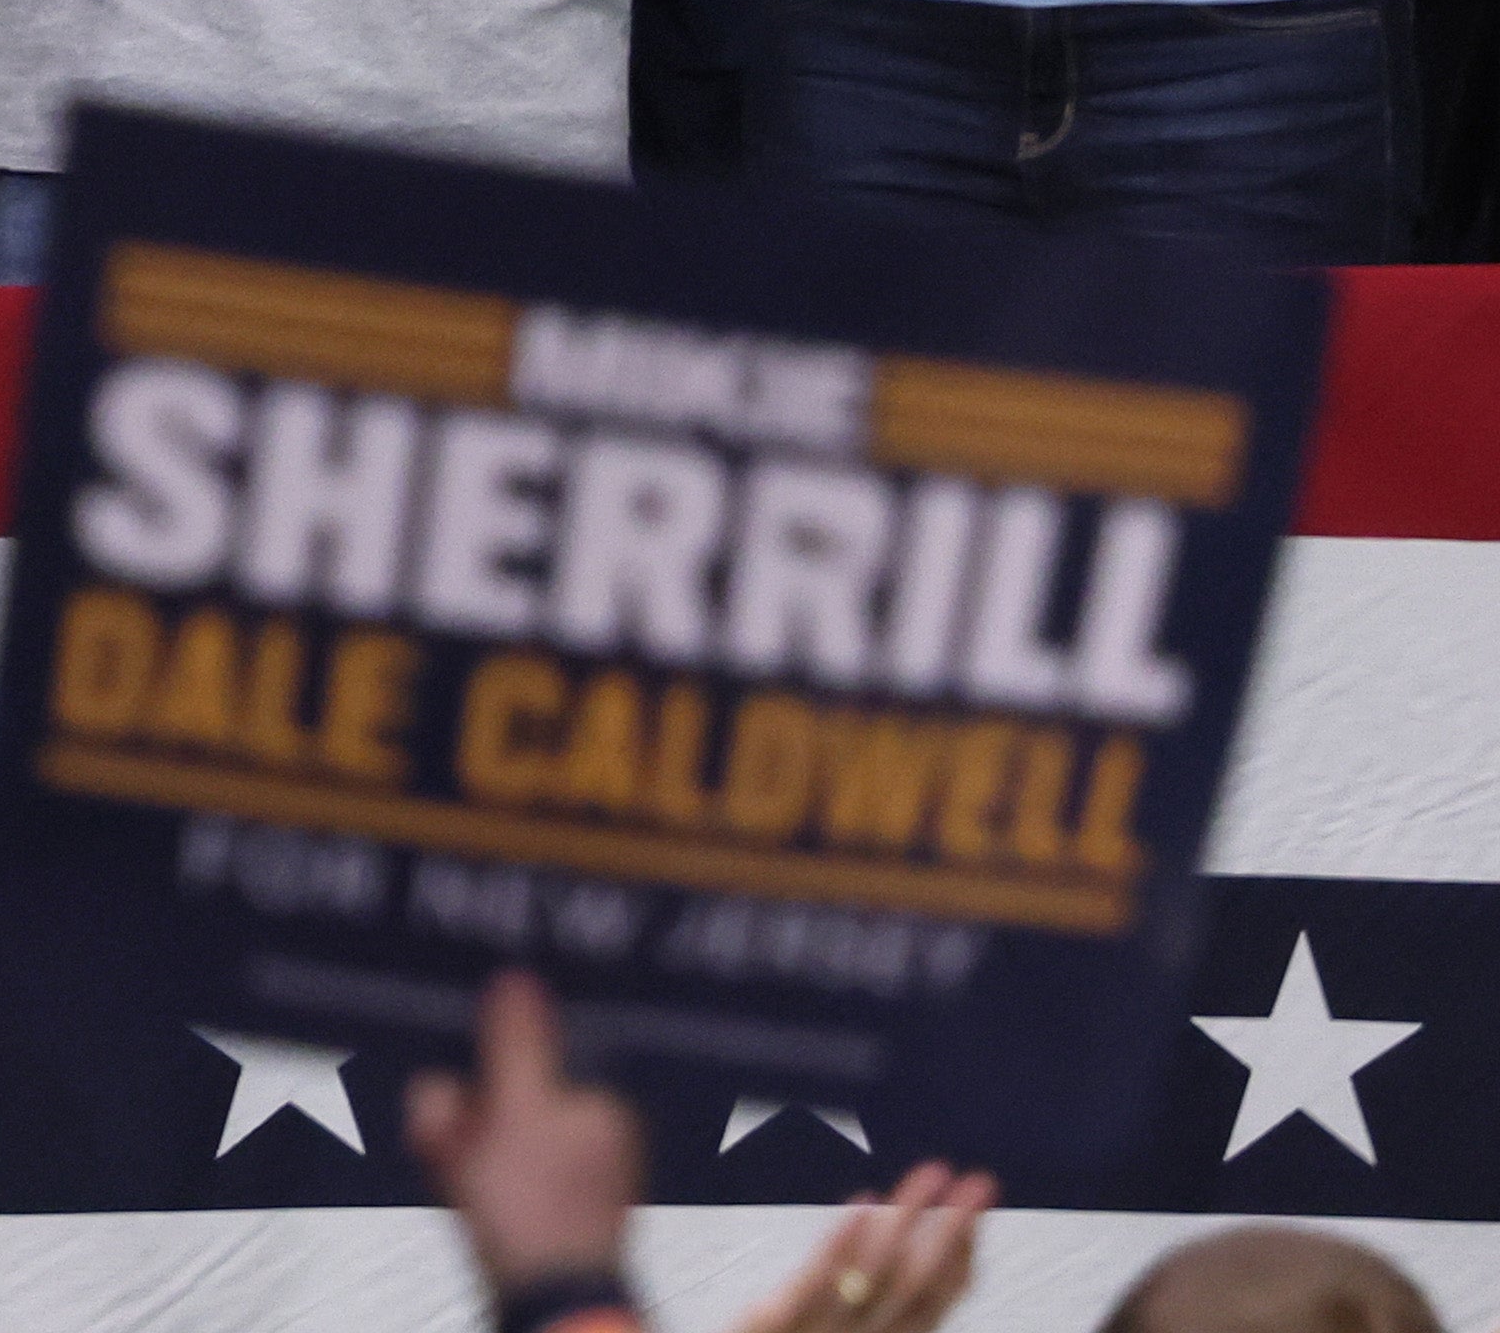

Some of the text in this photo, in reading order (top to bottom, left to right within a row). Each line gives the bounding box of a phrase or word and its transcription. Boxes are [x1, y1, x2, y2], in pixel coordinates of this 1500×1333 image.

[72, 355, 1194, 725] SHERRILL
[50, 585, 1145, 869] DALE CALDWELL
